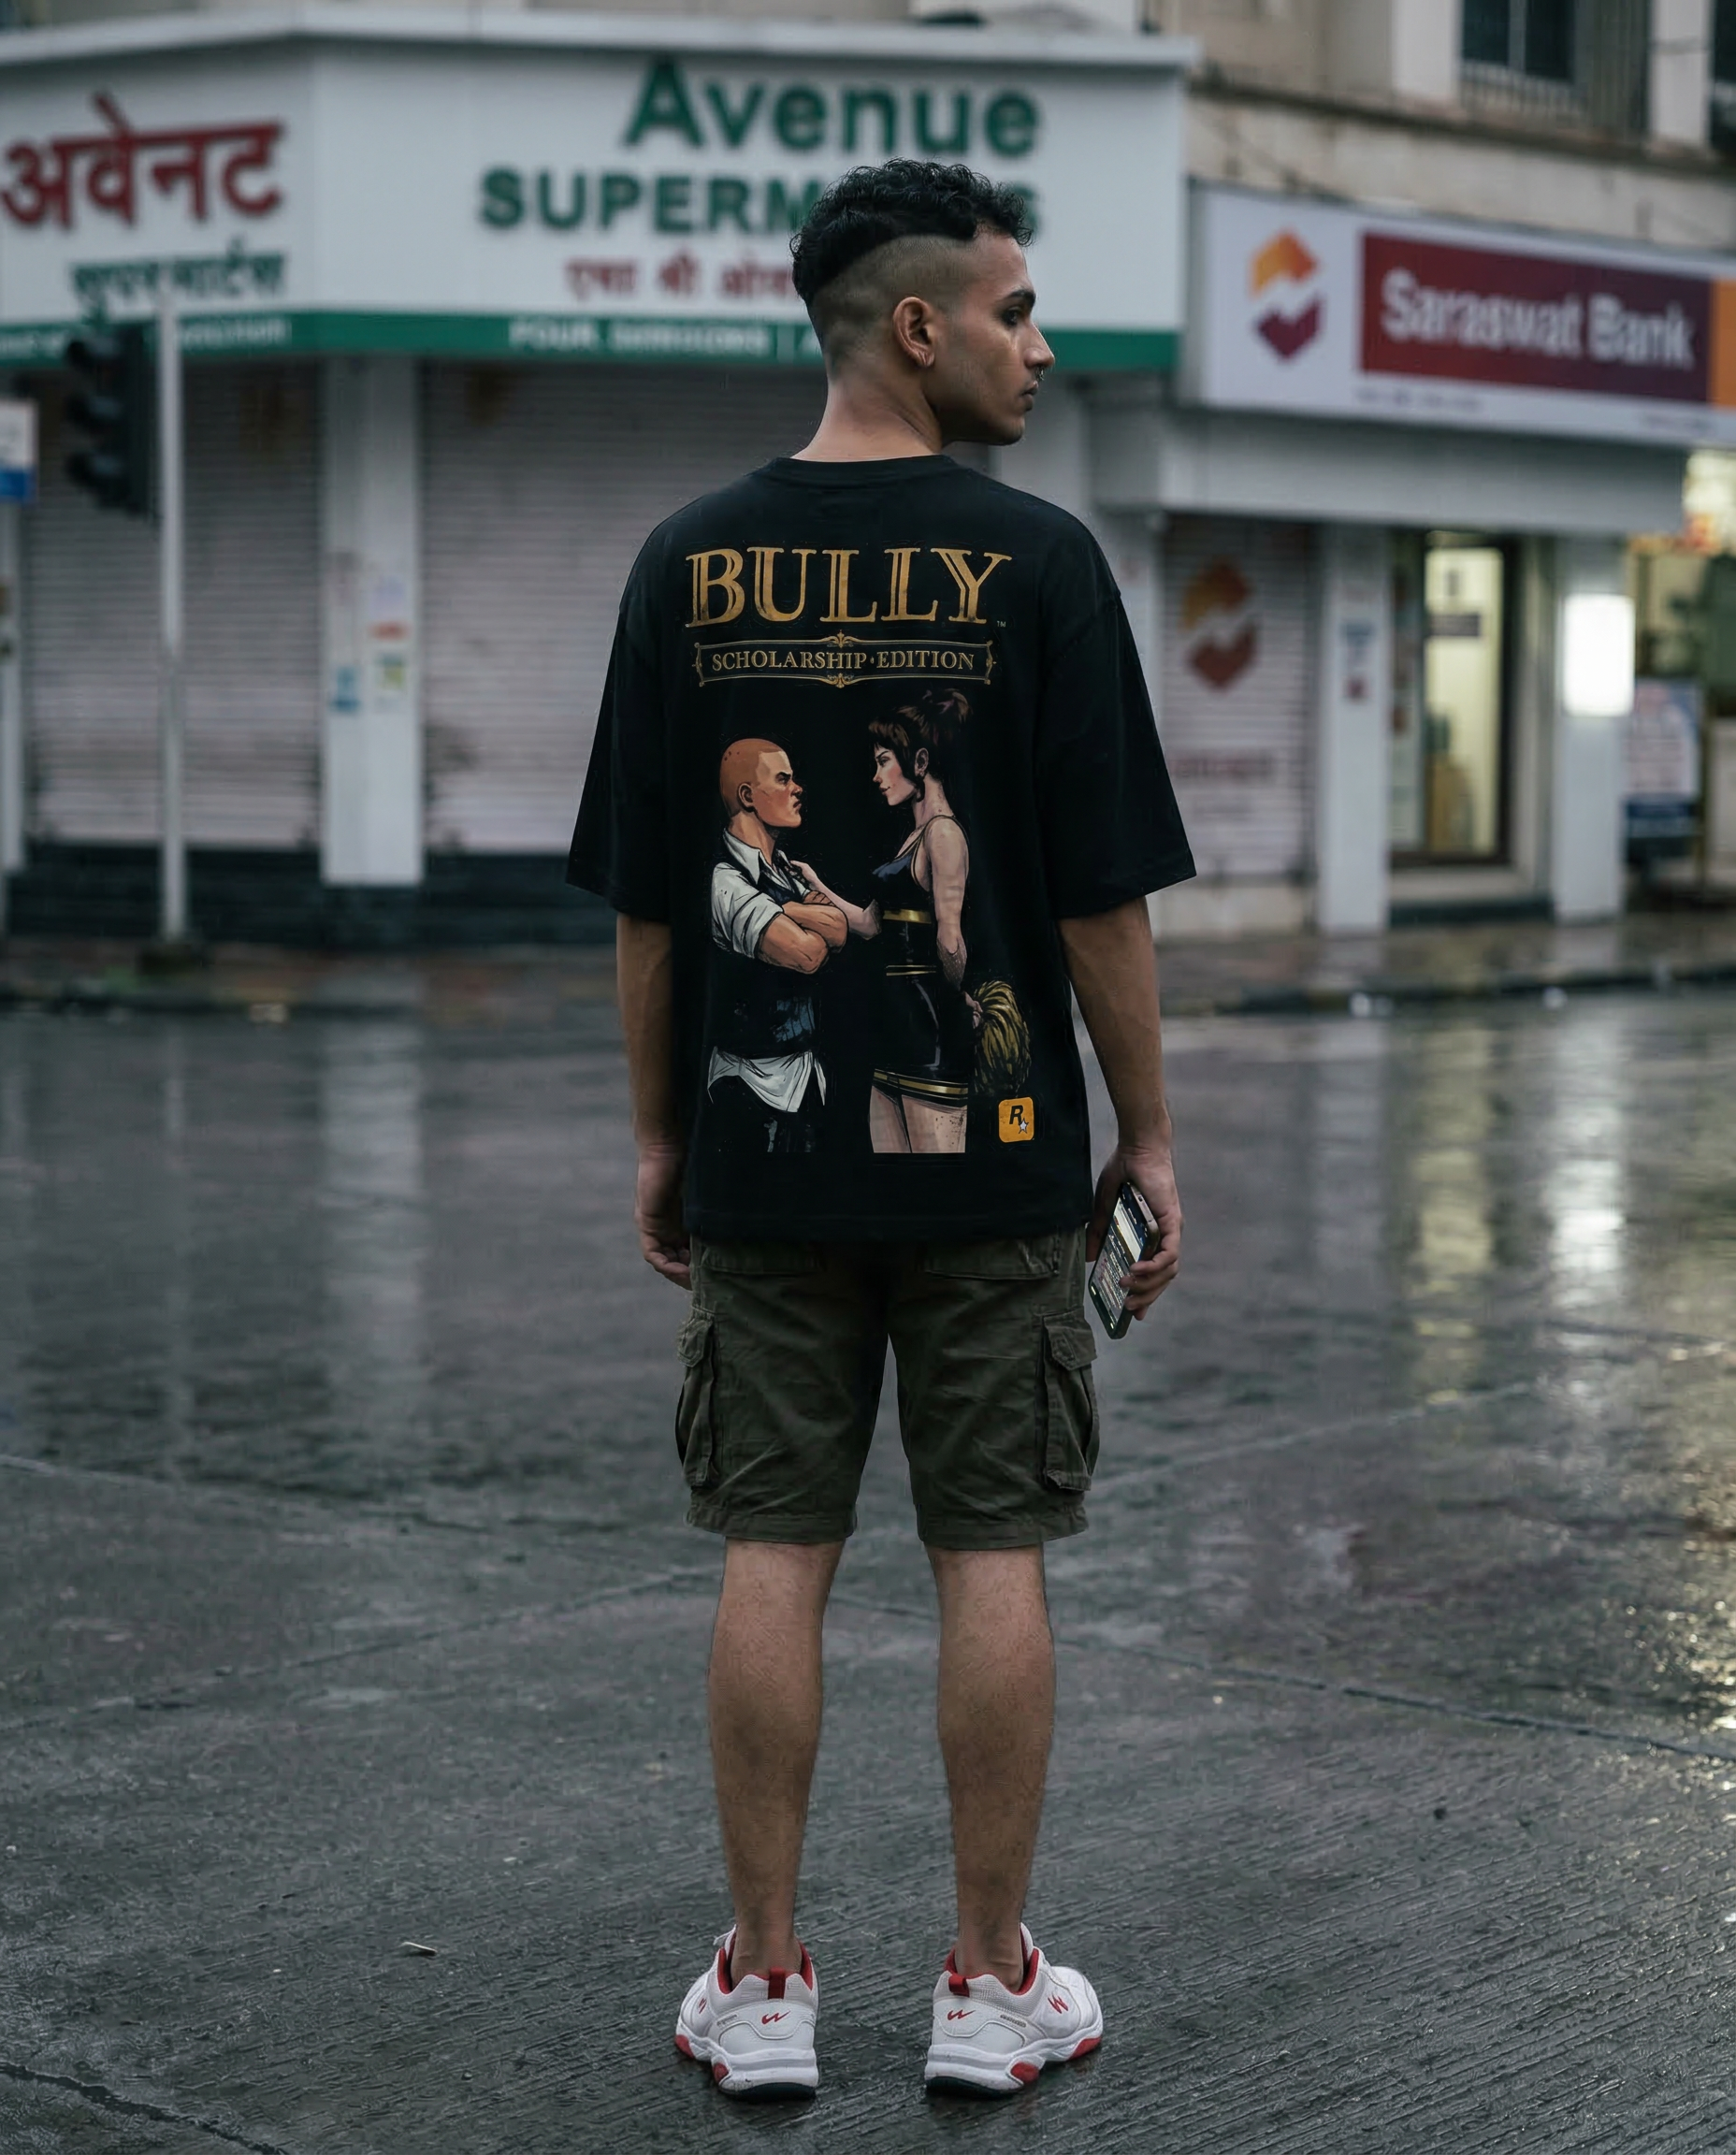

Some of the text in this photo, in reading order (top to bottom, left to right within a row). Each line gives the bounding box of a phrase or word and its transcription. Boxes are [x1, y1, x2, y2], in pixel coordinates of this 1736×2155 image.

[624, 53, 1039, 157] Avenue
[478, 165, 1041, 236] SUPERM
[1382, 266, 1696, 372] Saraswat Bank
[685, 546, 1012, 628] BULLY
[712, 649, 975, 672] SCHOLARSHIP EDITION
